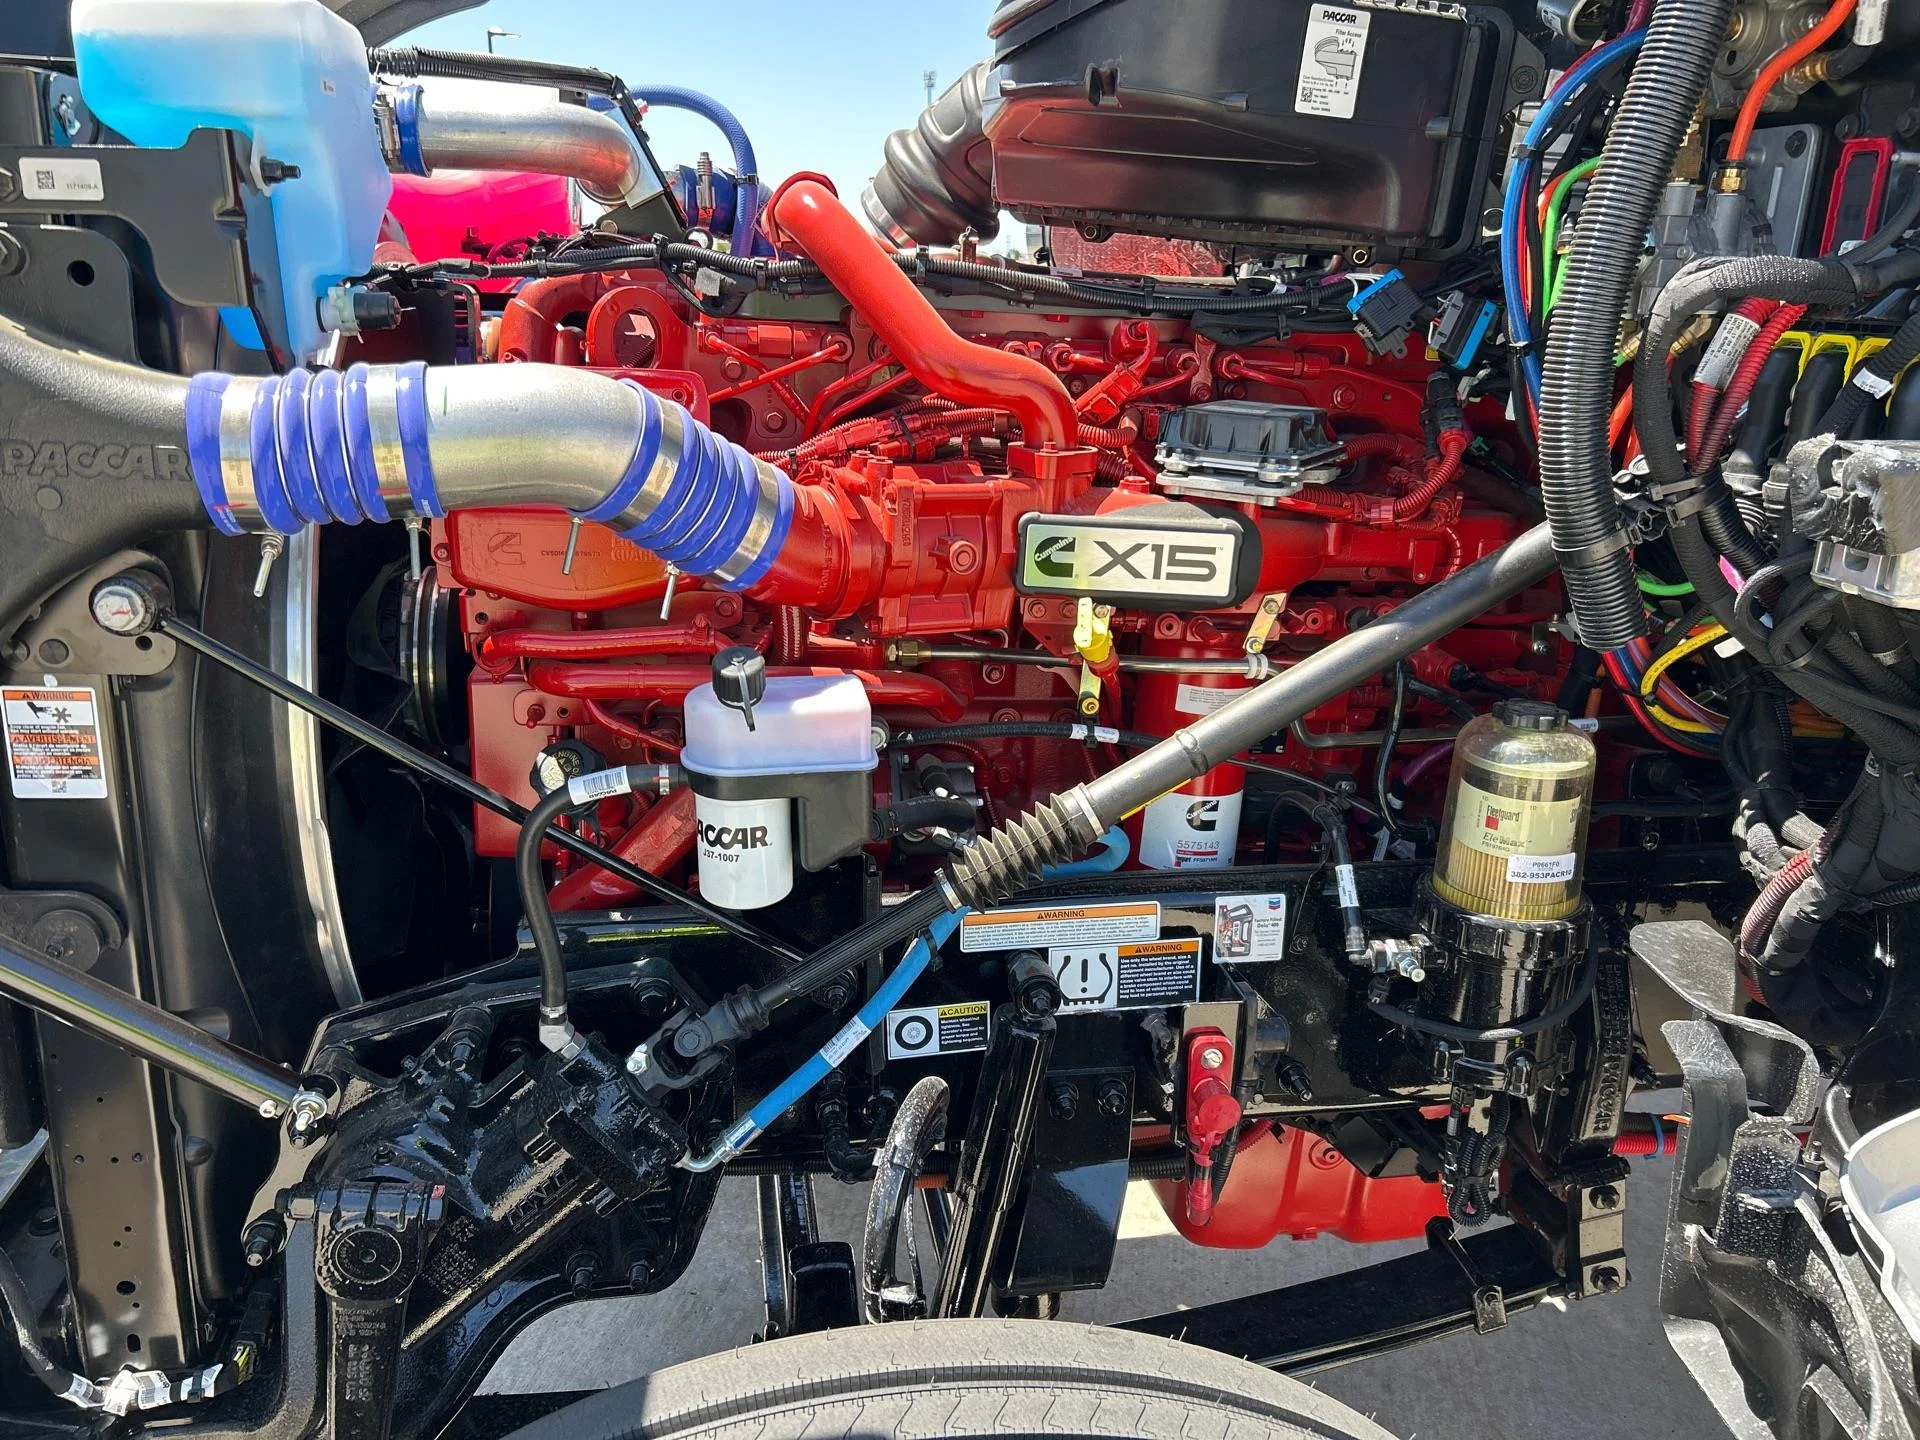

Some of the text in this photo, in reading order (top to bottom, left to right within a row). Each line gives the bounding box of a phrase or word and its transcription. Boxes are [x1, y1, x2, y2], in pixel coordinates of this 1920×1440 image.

[1322, 10, 1357, 24] PACCAR
[0, 440, 193, 481] PACCAR
[1034, 536, 1073, 562] Cummins
[1089, 541, 1216, 582] X15
[31, 691, 74, 699] WARNING
[553, 751, 580, 766] ENGINE
[1186, 800, 1218, 820] Cummins
[1487, 805, 1520, 822] Fleetguard
[698, 819, 768, 850] ACCAR
[1177, 840, 1219, 849] 5575143
[703, 848, 740, 862] J37-1007
[1044, 910, 1085, 919] WARNING
[1142, 943, 1182, 953] WARNING
[947, 1005, 986, 1016] CAUTION
